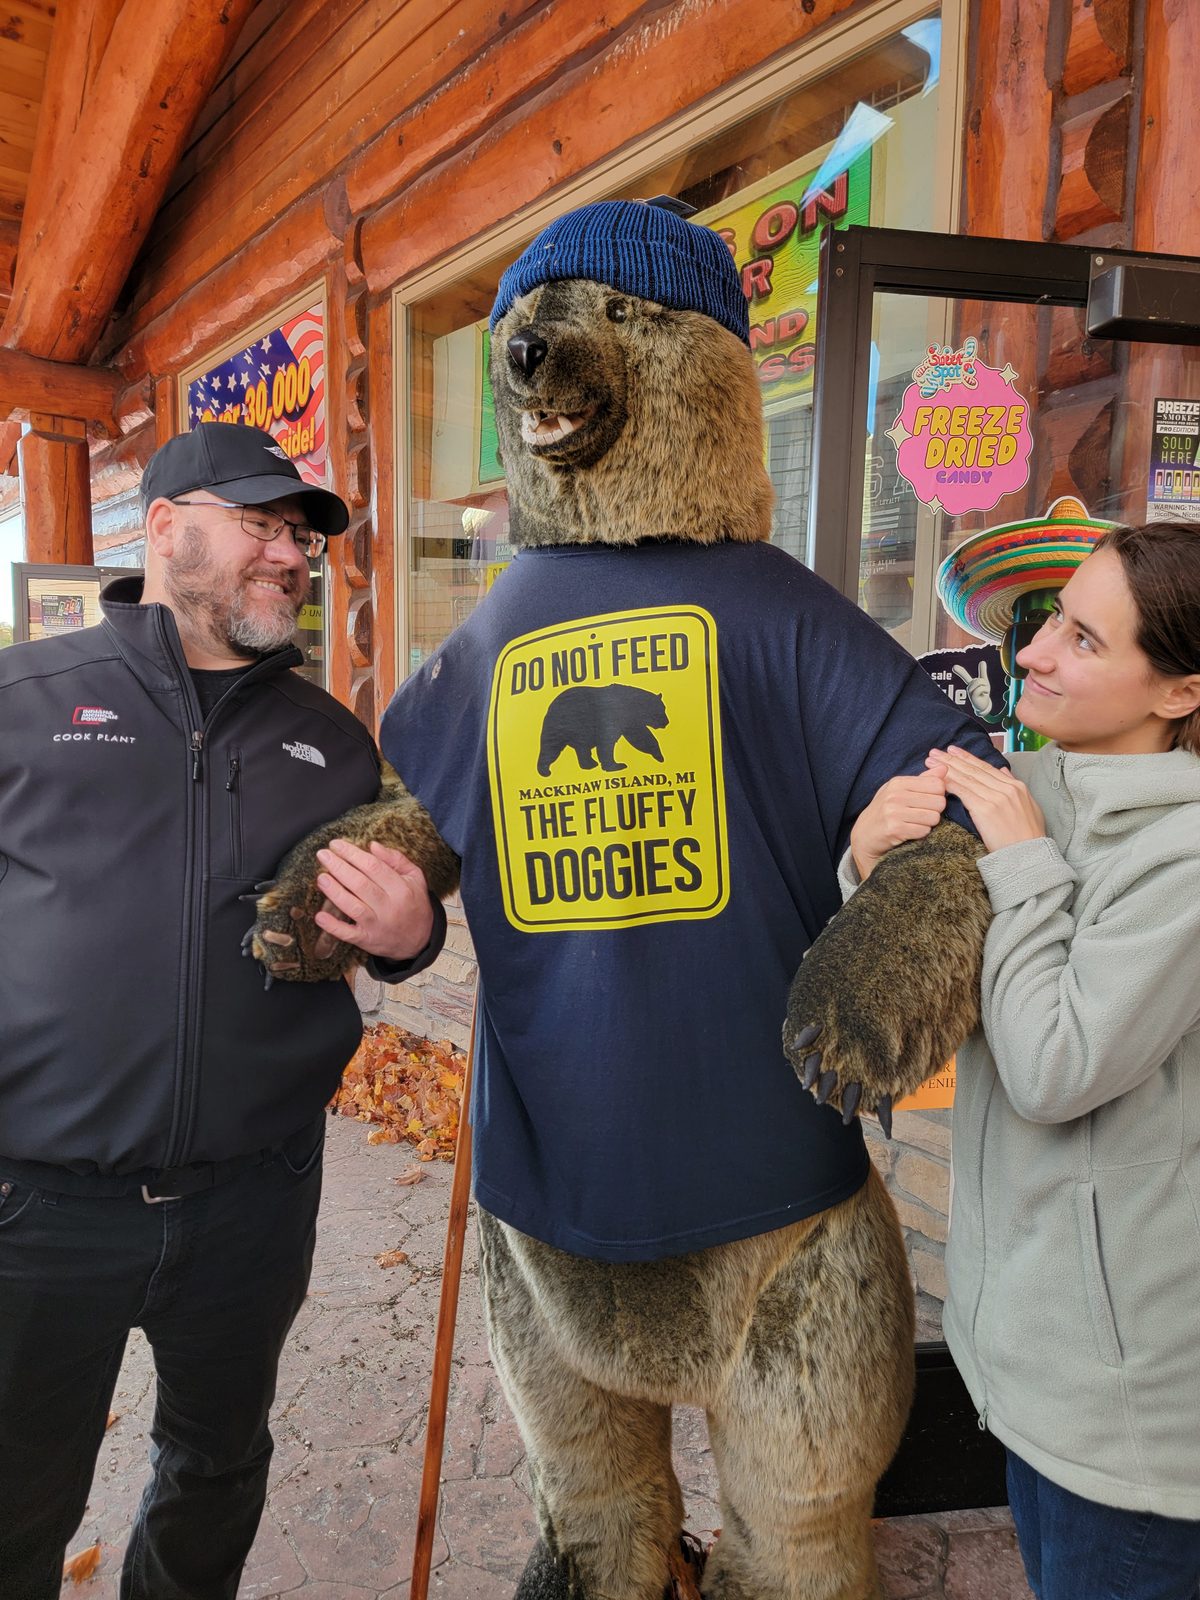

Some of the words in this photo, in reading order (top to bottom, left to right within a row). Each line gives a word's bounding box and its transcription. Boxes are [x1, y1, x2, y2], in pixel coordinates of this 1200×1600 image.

[752, 170, 848, 250] ON
[928, 353, 963, 367] Sweet
[931, 365, 962, 386] Spot
[243, 355, 312, 432] 30,000
[1156, 400, 1200, 415] BREEZE
[913, 405, 1025, 437] FREEZE
[1162, 414, 1192, 422] SMOKE
[1162, 436, 1192, 450] SOLD
[924, 435, 1018, 469] DRIED
[1161, 450, 1192, 464] HERE
[935, 470, 993, 485] CANDY
[510, 656, 545, 696] DO
[551, 642, 604, 688] NOT
[611, 632, 690, 678] FEED
[931, 670, 953, 681] sale
[52, 733, 92, 742] COOK
[96, 733, 136, 744] PLANT
[294, 741, 311, 751] THE
[282, 742, 311, 756] NORTH
[290, 751, 312, 762] FACE
[518, 779, 602, 801] MACKINAW
[604, 772, 673, 791] ISLAND,
[676, 771, 697, 784] MI
[519, 800, 578, 841] THE
[584, 788, 697, 835] FLUFFY
[523, 837, 704, 907] DOGGIES
